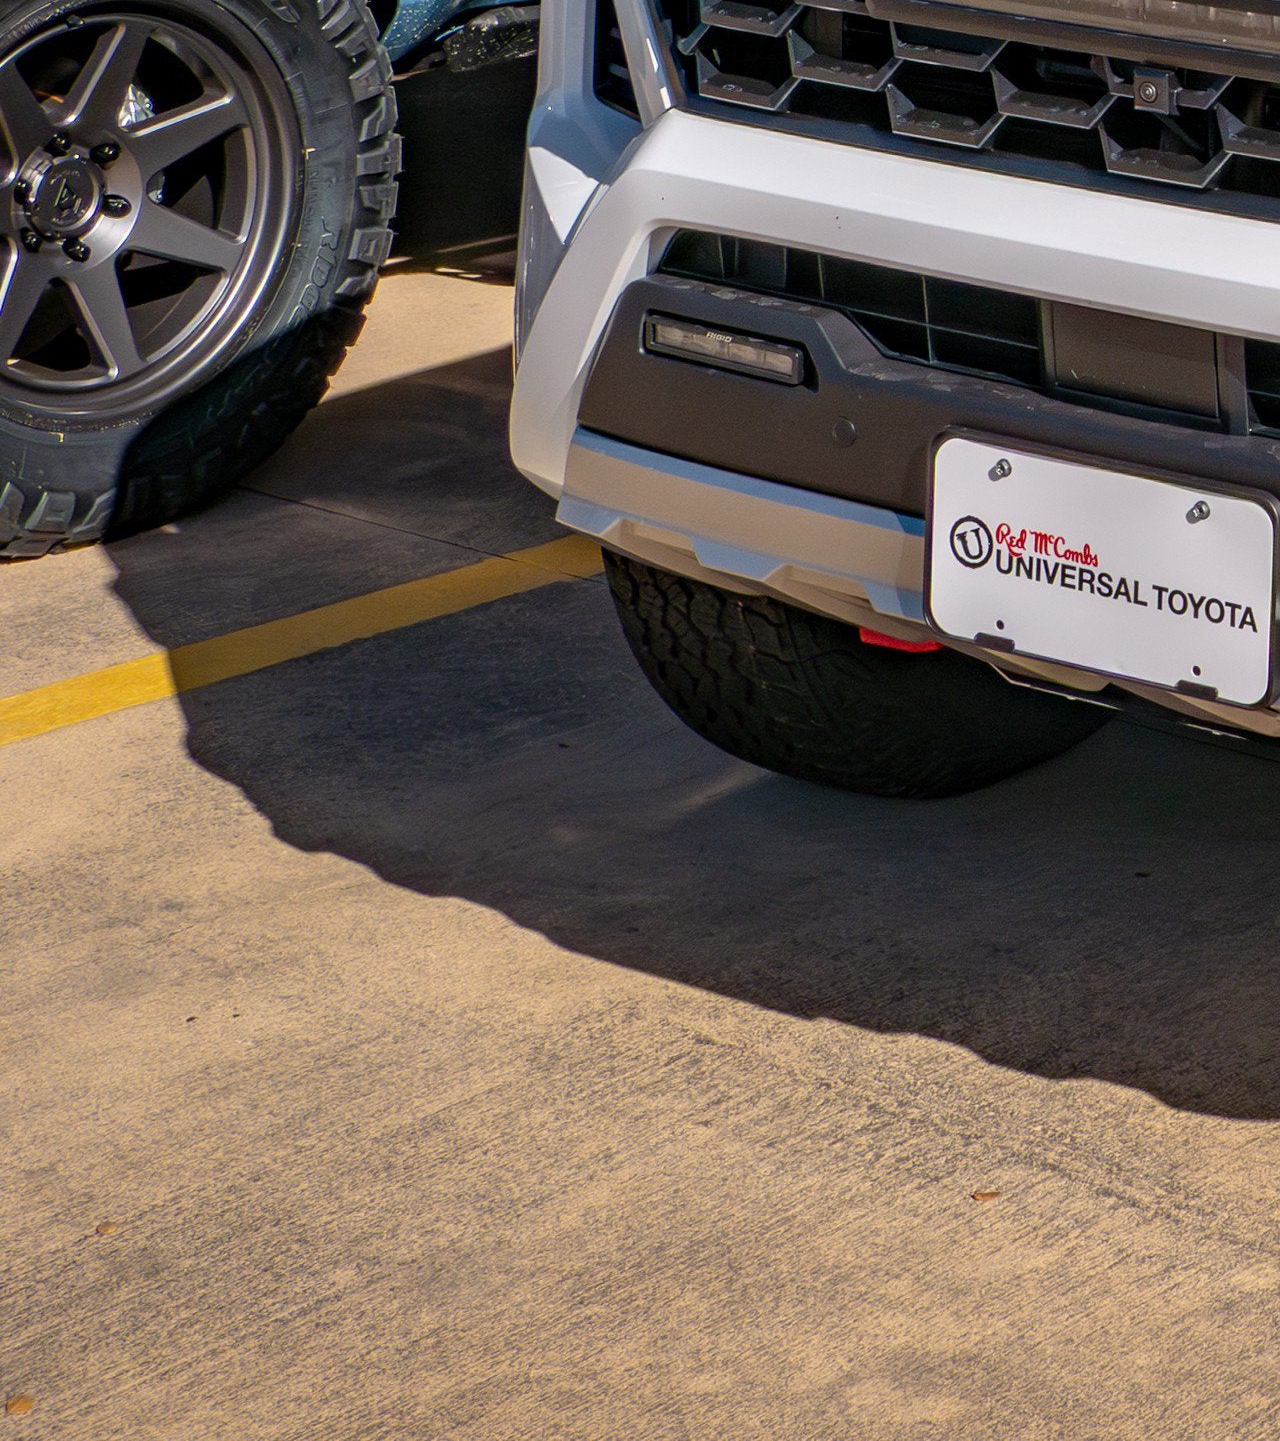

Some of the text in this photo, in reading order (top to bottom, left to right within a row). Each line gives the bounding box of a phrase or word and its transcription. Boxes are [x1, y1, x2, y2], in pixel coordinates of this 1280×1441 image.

[706, 331, 733, 343] RIGID
[996, 523, 1099, 568] Red McCombs
[996, 549, 1258, 633] UNIVERSAL TOYOTA
